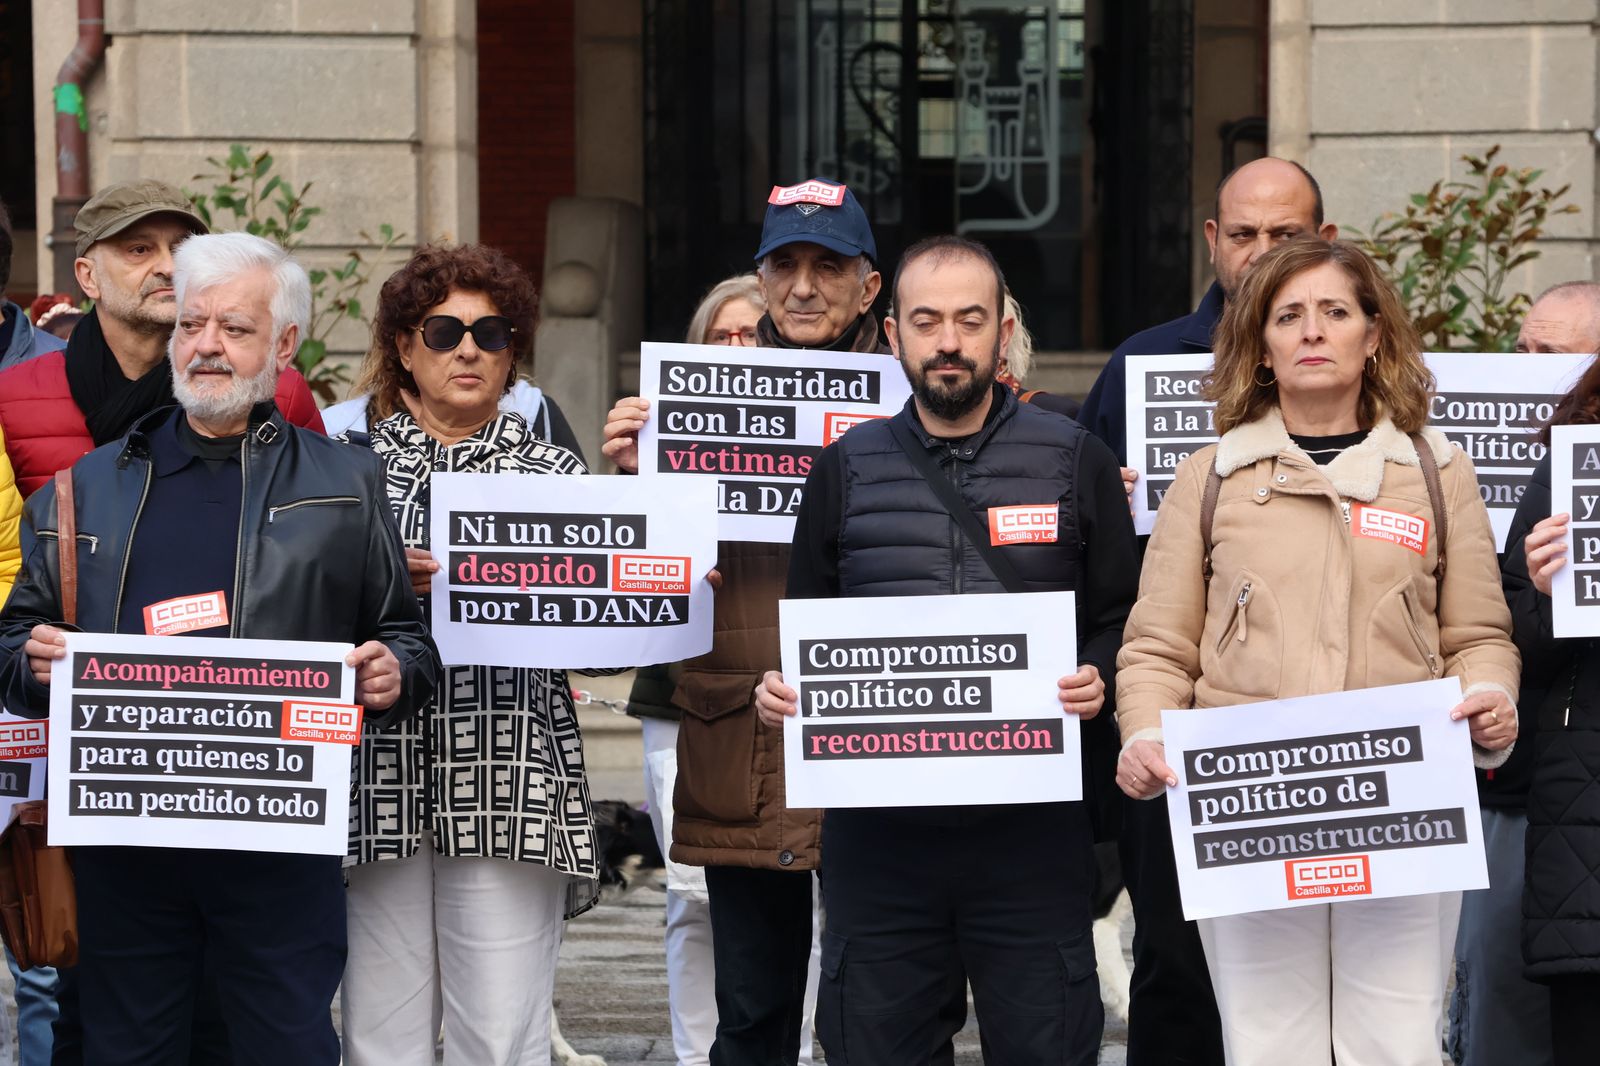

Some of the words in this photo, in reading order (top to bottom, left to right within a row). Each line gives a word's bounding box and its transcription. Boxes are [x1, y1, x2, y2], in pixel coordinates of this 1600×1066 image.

[784, 184, 834, 197] CCOO
[667, 365, 871, 401] Solidaridad
[1154, 376, 1212, 396] Rec
[666, 410, 728, 435] con
[736, 407, 786, 436] las
[1153, 415, 1168, 431] a
[1175, 410, 1199, 431] la
[1429, 395, 1559, 428] Compro
[665, 444, 813, 476] víctimas
[1449, 434, 1547, 461] lítico
[718, 483, 748, 512] la
[1580, 495, 1599, 521] y
[457, 514, 498, 543] Ni
[508, 523, 553, 544] un
[563, 518, 635, 546] solo
[1002, 512, 1057, 527] CCOO
[1366, 513, 1420, 535] CCOO
[998, 531, 1032, 541] Castilla
[1034, 532, 1040, 540] y
[1360, 527, 1394, 541] Castilla
[1403, 536, 1422, 551] León
[457, 553, 597, 591] despido
[625, 563, 679, 576] CCOO
[619, 580, 652, 589] Castilla
[654, 583, 660, 591] y
[662, 581, 684, 590] León
[156, 600, 213, 621] CCOO
[458, 598, 519, 623] por
[530, 595, 562, 622] la
[572, 597, 680, 624] DANA
[153, 621, 187, 635] Castilla
[190, 620, 196, 628] y
[197, 615, 222, 626] León
[808, 637, 1017, 674] Compromiso
[81, 656, 330, 689] Acompañamiento
[809, 680, 933, 717] político
[943, 680, 982, 707] de
[79, 703, 98, 729] y
[105, 703, 273, 731] reparación
[296, 709, 352, 725] CCOO
[289, 728, 324, 739] Castilla
[326, 732, 332, 741] y
[334, 731, 356, 741] León
[810, 723, 1053, 754] reconstrucción
[15, 748, 21, 757] y
[23, 746, 47, 755] León
[79, 746, 148, 772] para
[156, 744, 269, 773] quienes
[276, 747, 304, 772] lo
[1194, 733, 1411, 777] Compromiso
[77, 785, 134, 810] han
[140, 787, 251, 817] perdido
[257, 792, 319, 817] todo
[1198, 783, 1327, 825] político
[1337, 776, 1377, 804] de
[1203, 814, 1456, 862] reconstrucción
[1299, 864, 1358, 880] CCOO
[1295, 885, 1330, 896] Castilla
[1333, 886, 1339, 894] y
[1342, 883, 1365, 893] León
